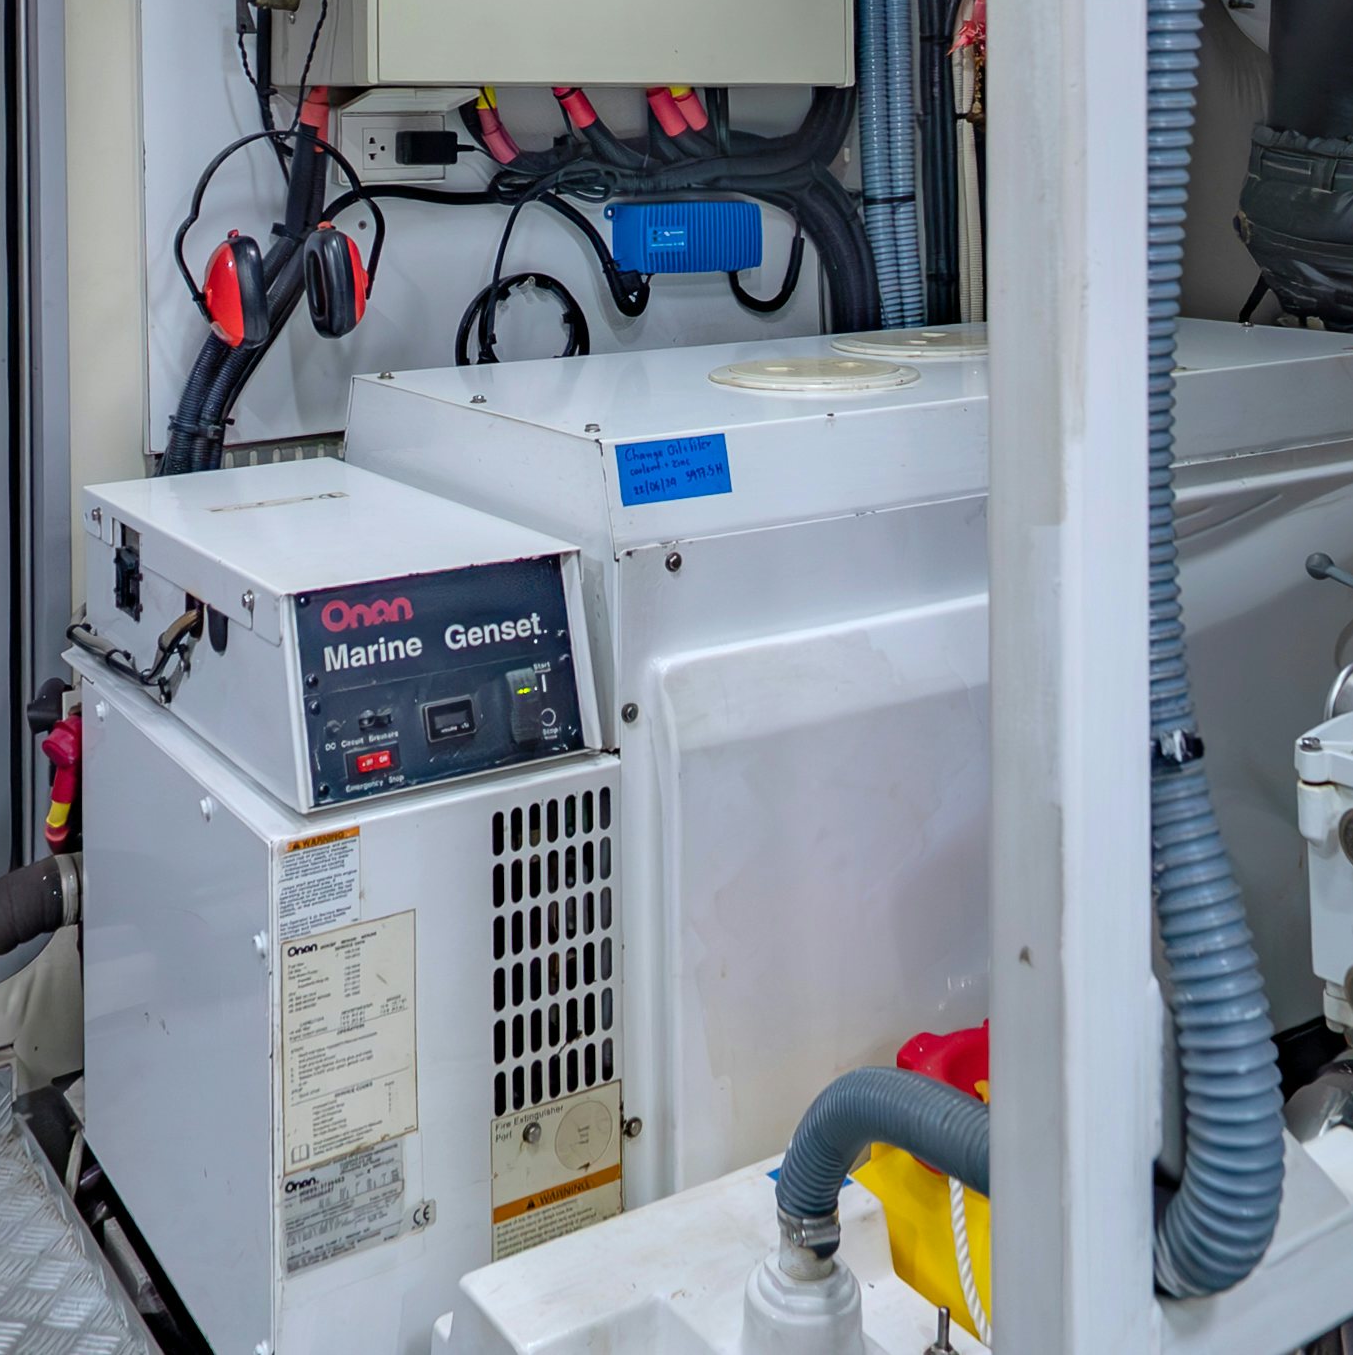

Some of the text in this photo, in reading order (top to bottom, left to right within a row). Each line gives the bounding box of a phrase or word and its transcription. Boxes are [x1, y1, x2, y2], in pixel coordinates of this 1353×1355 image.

[624, 447, 663, 463] Change
[321, 597, 414, 632] Onan
[323, 612, 542, 672] Marine Genset
[302, 831, 345, 848] WARNING
[287, 943, 318, 958] Onan
[495, 1105, 564, 1131] Fire Extinguisher
[495, 1131, 513, 1143] Port
[285, 1176, 317, 1193] Onan
